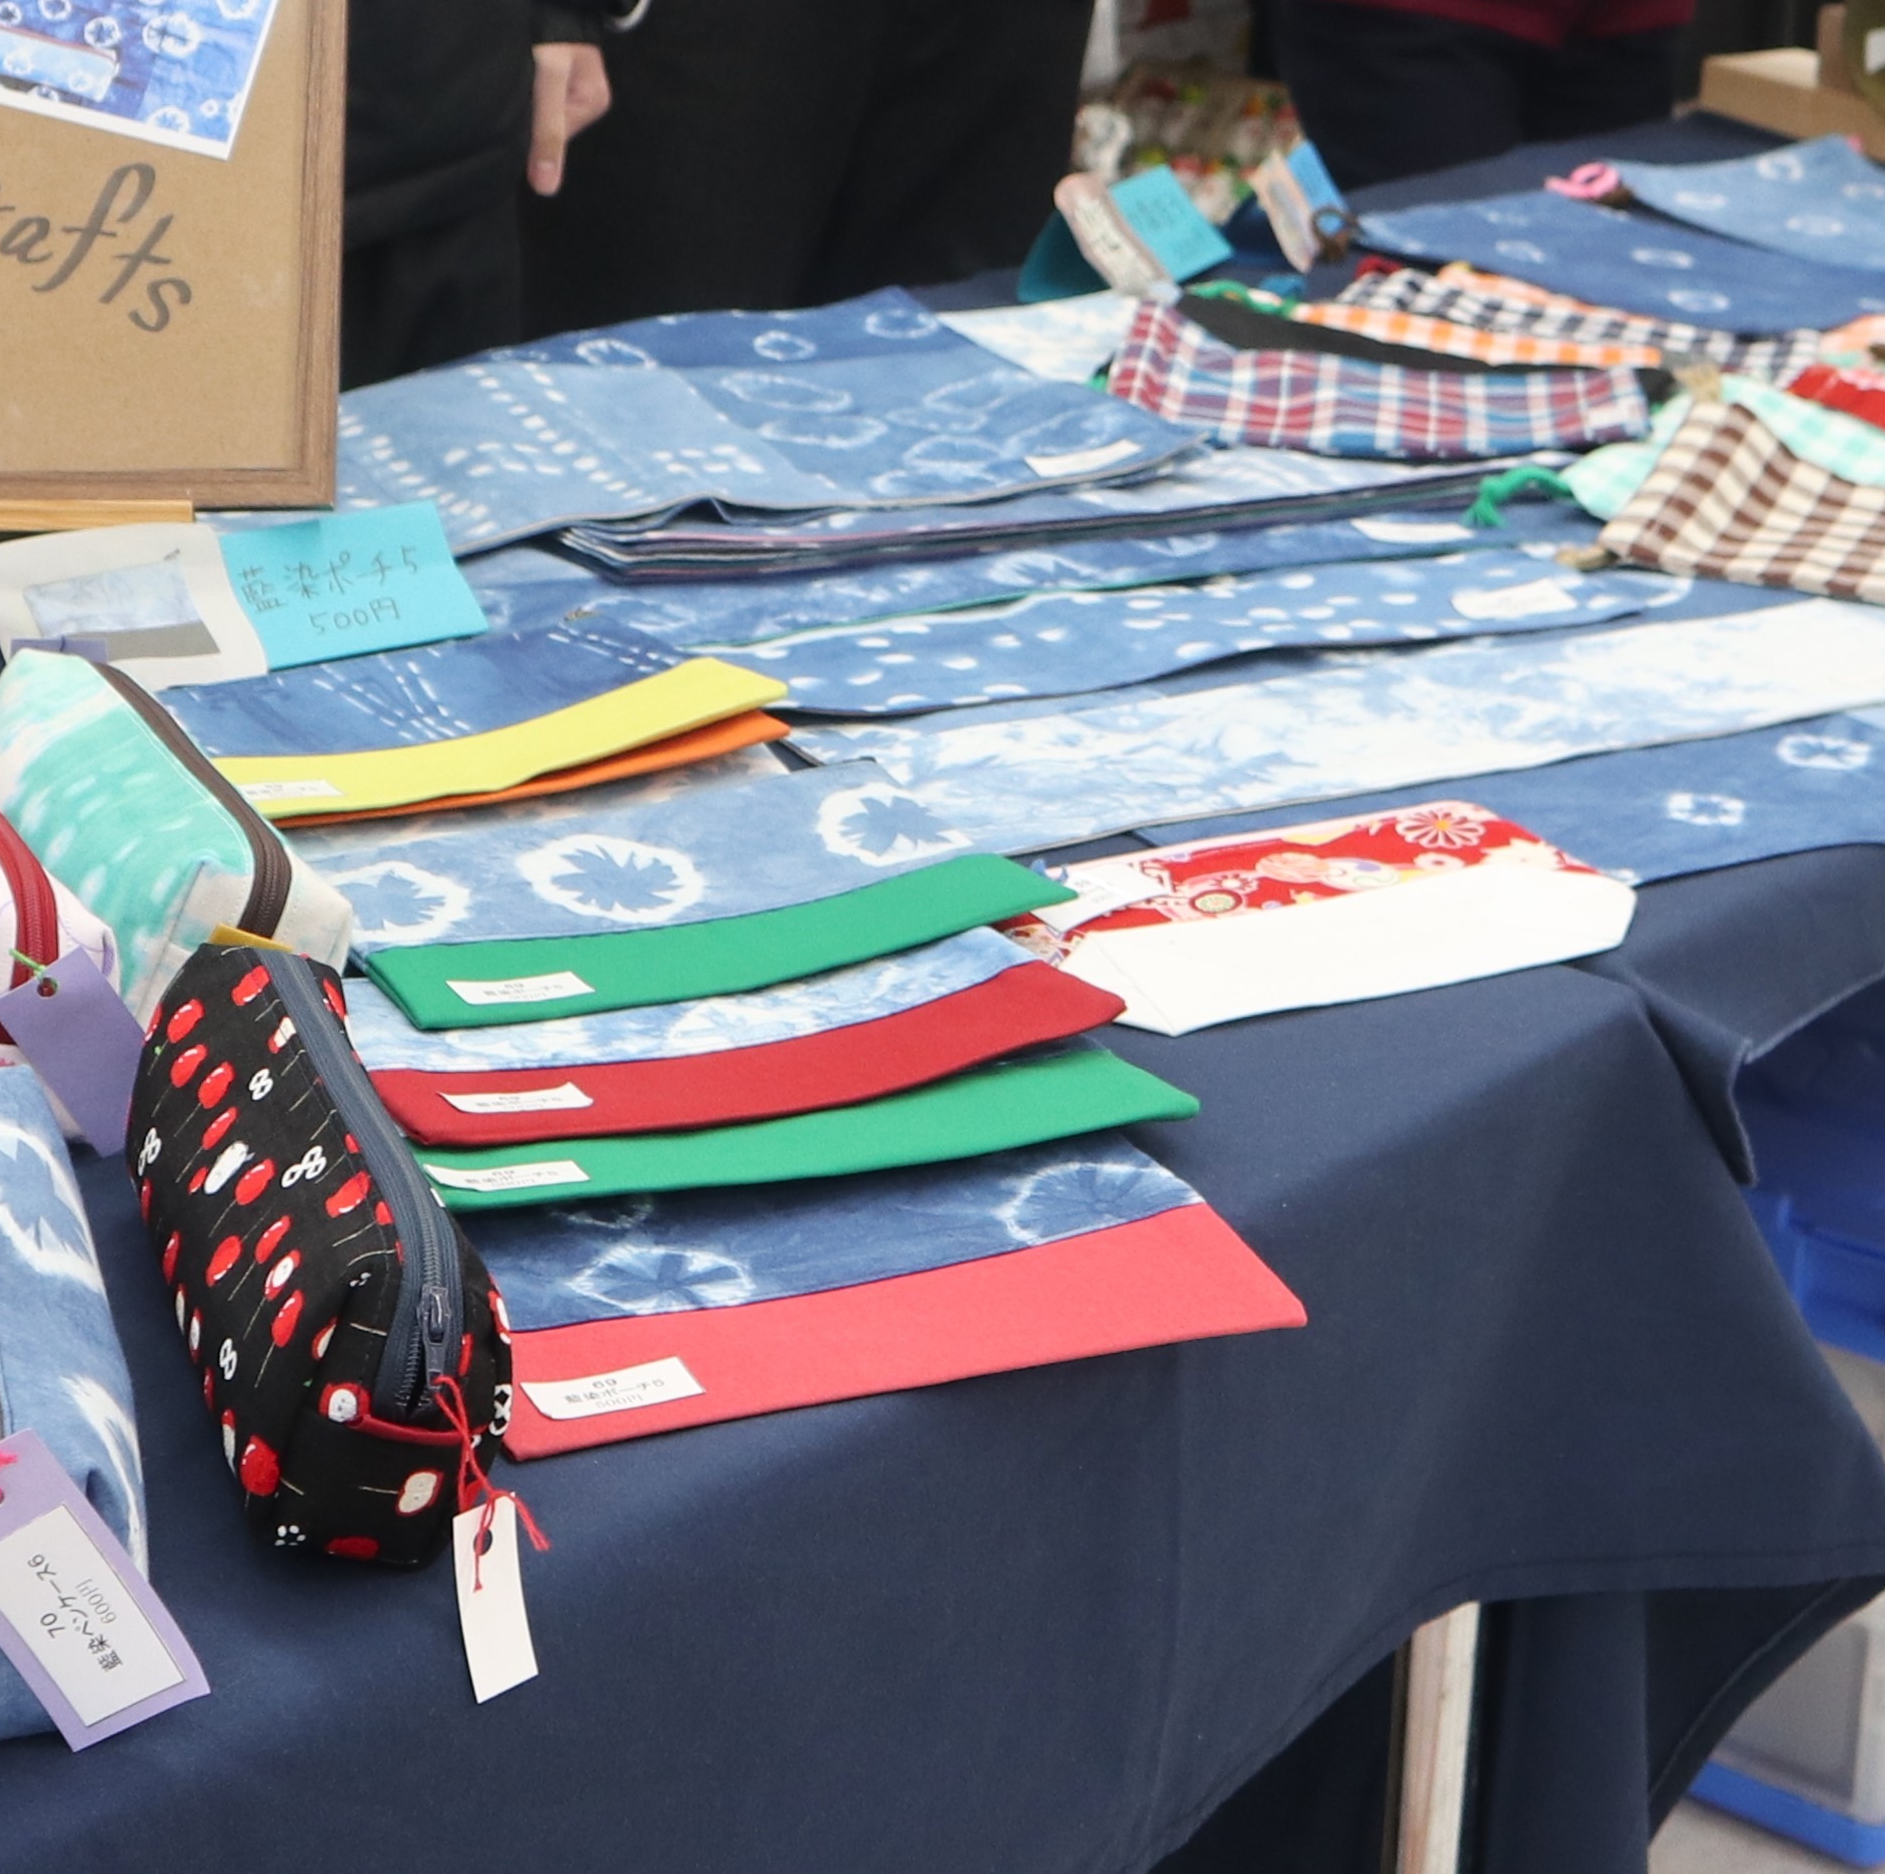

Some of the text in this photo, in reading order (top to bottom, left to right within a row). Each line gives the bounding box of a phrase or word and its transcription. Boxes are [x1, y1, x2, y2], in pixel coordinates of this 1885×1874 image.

[308, 597, 401, 635] 500円
[27, 1554, 123, 1672] 藍染ペンケース6
[75, 1578, 117, 1624] 600円
[40, 1612, 66, 1639] 70
